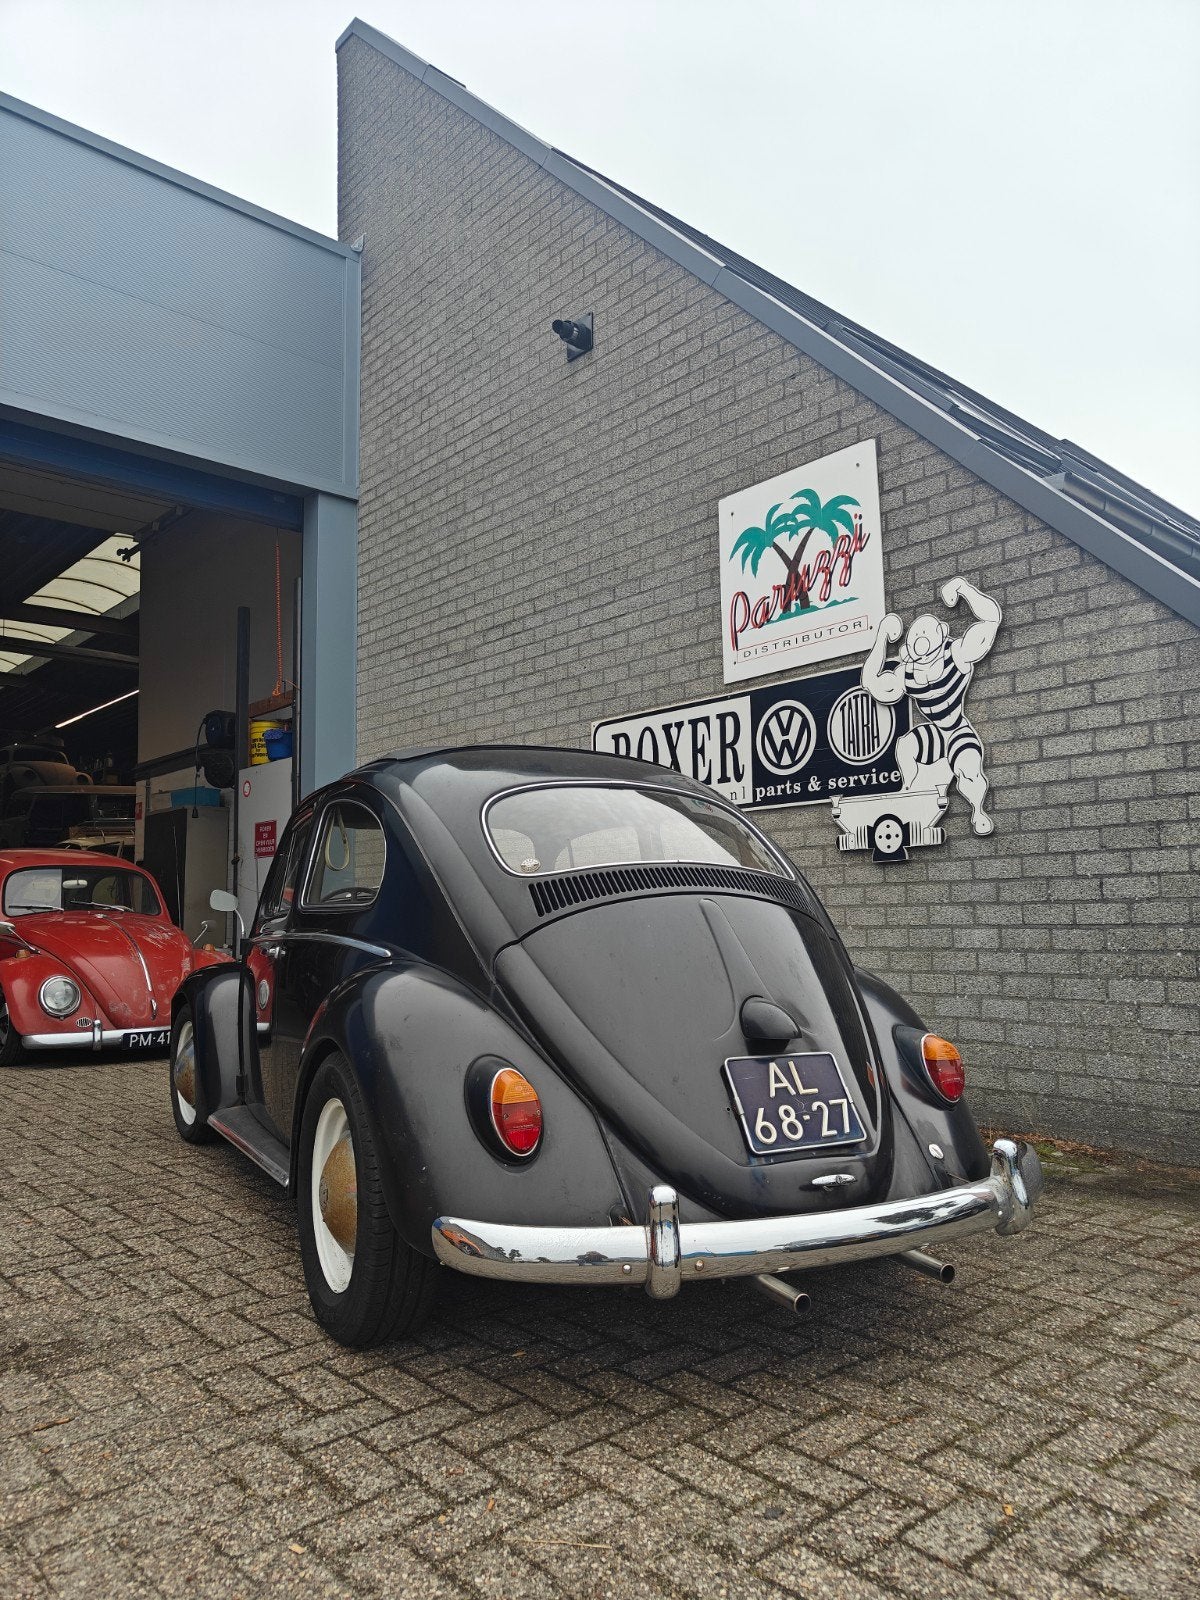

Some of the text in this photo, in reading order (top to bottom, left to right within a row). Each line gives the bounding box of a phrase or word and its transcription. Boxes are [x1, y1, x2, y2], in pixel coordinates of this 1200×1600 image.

[730, 513, 870, 651] Paruzzi
[743, 620, 863, 658] DISTRIBUTOR
[840, 693, 881, 758] TATRA
[755, 768, 900, 801] parts & service
[768, 1060, 819, 1098] AL
[754, 1098, 850, 1145] 68-27
